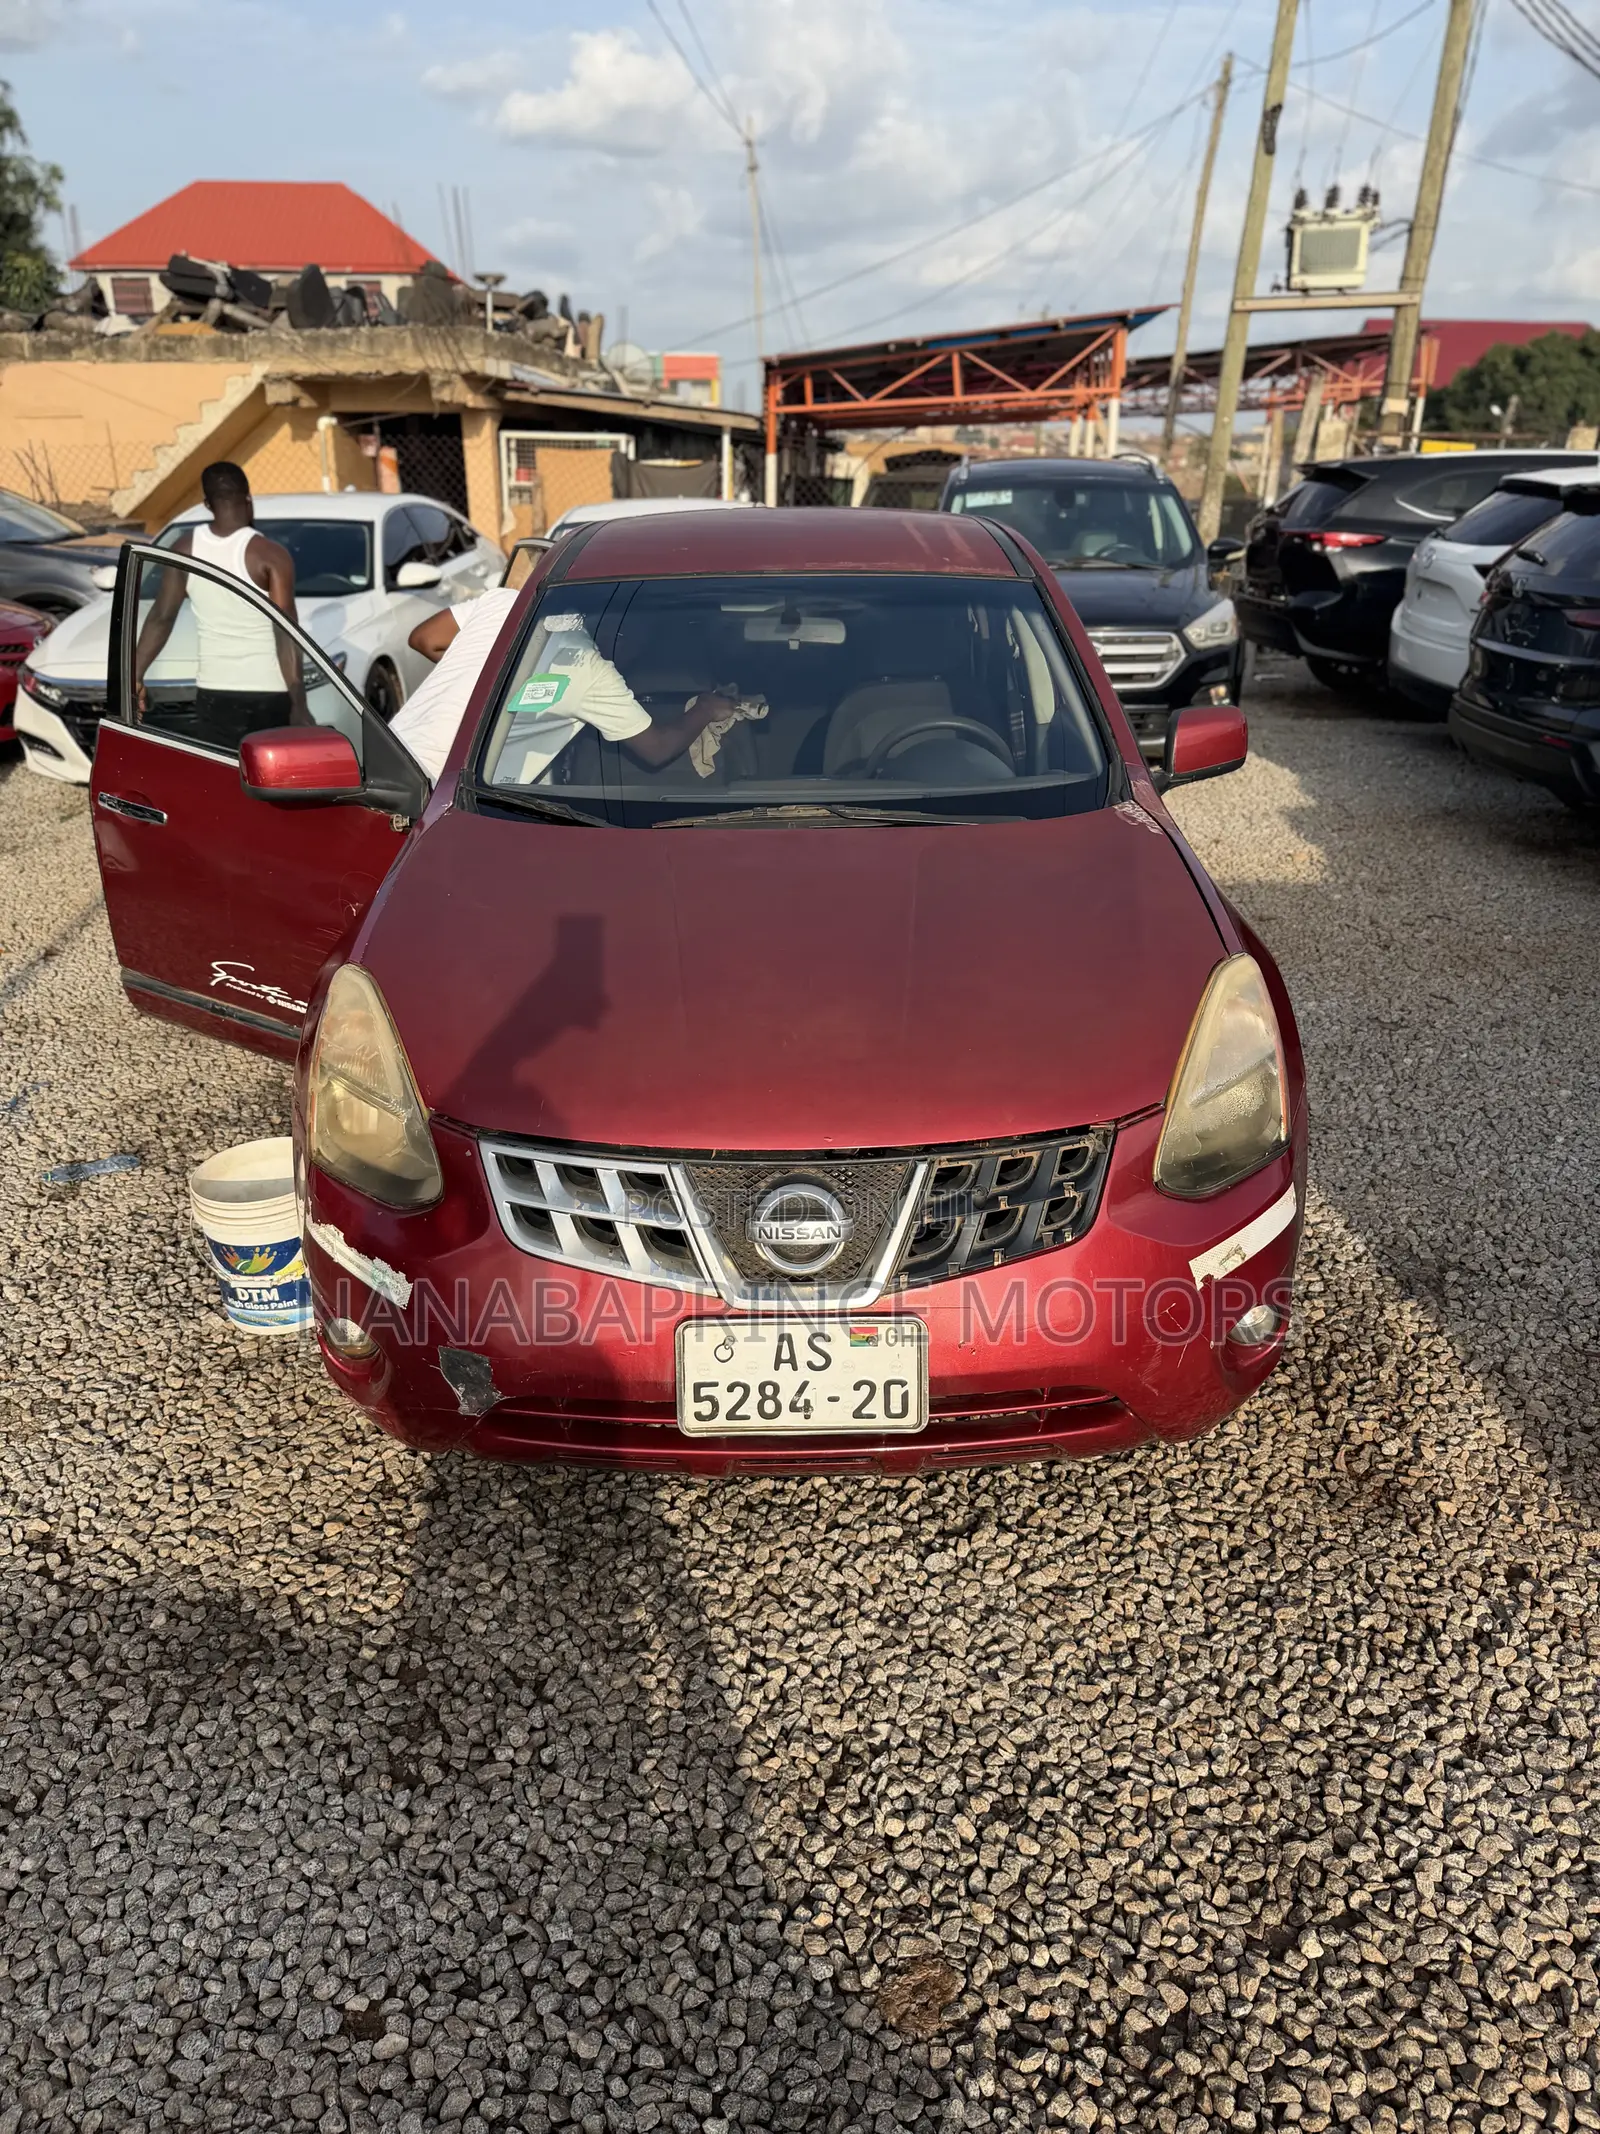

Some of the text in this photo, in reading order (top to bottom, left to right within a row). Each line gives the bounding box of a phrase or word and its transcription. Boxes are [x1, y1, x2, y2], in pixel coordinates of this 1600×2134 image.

[757, 1225, 843, 1241] NISSAN
[236, 1287, 280, 1302] DTM
[244, 1302, 270, 1311] Gloss
[270, 1298, 299, 1310] Paint
[885, 1326, 915, 1348] GH
[773, 1332, 833, 1372] AS
